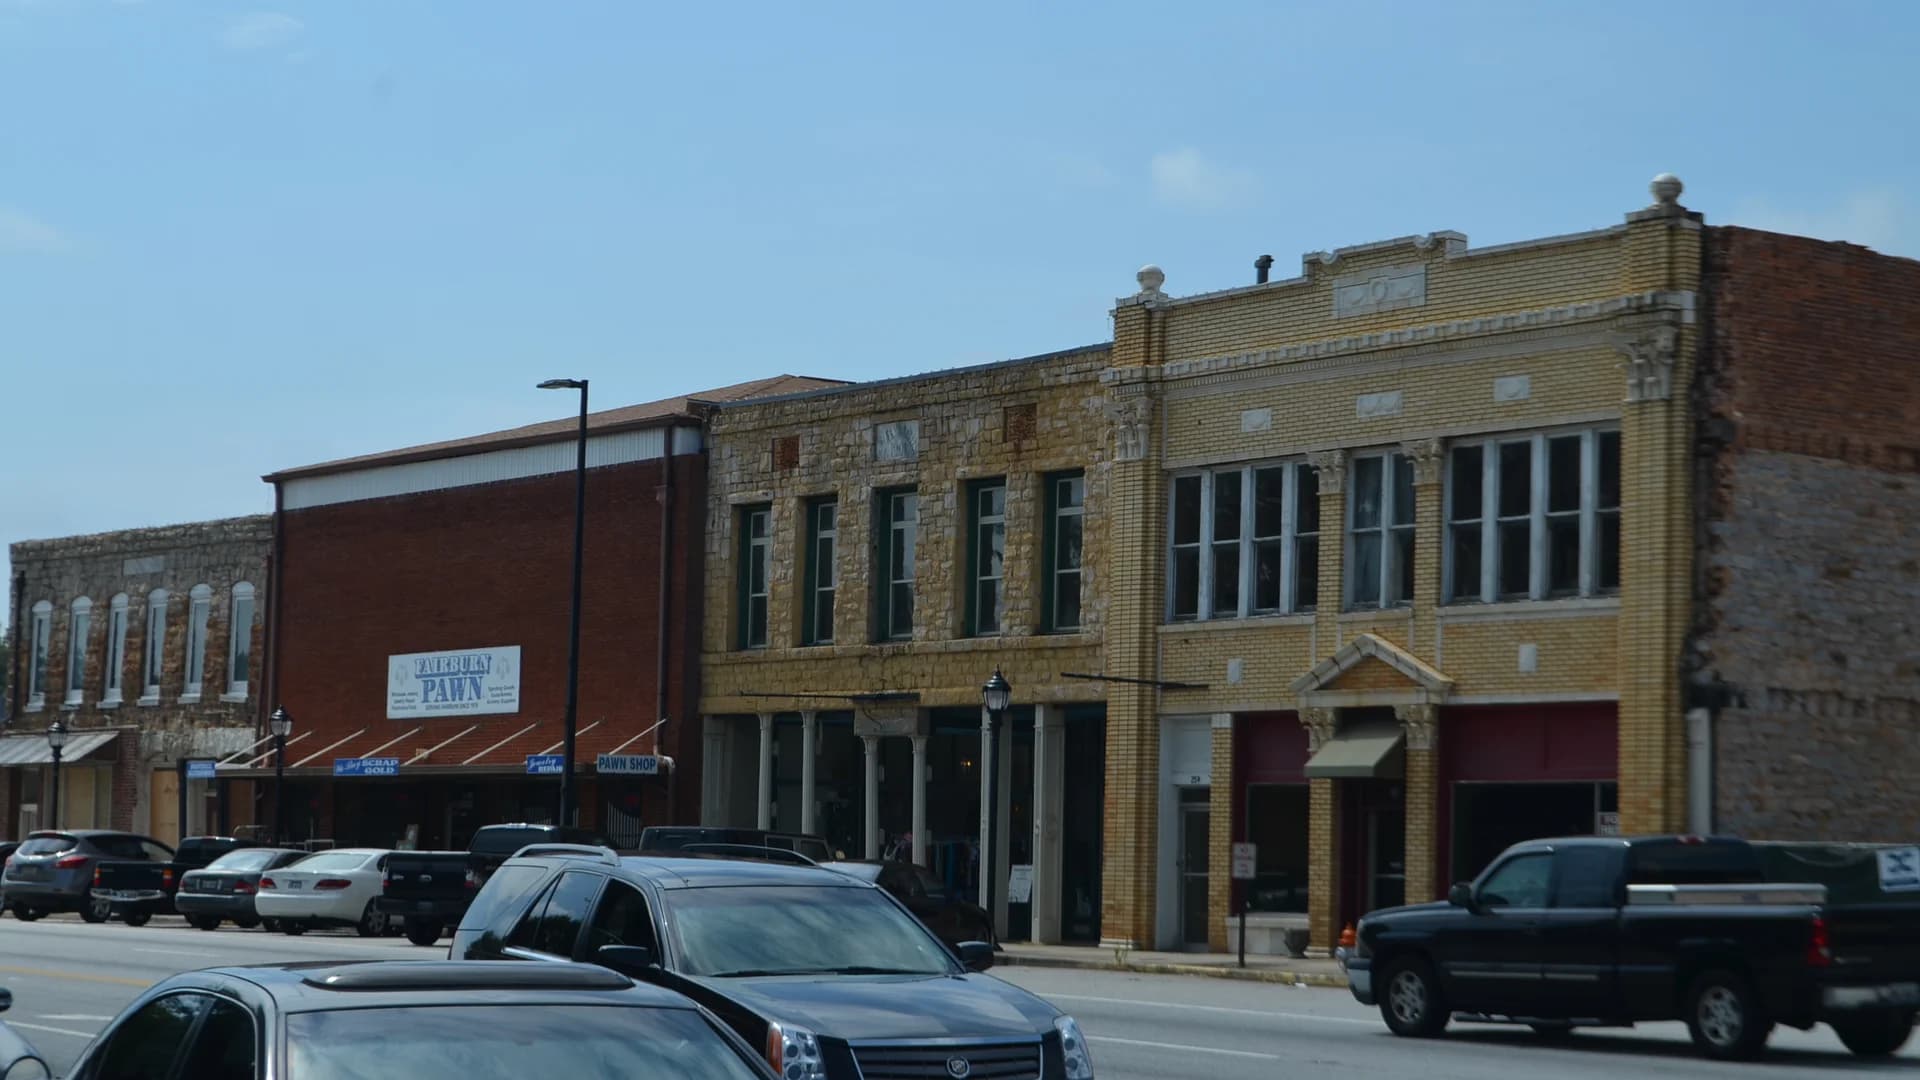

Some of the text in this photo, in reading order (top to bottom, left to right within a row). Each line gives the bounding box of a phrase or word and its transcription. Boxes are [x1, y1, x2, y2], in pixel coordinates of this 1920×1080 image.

[415, 653, 492, 676] FAIRBURN
[421, 675, 484, 703] PAWN
[361, 759, 399, 767] SCRAP
[364, 766, 395, 774] GOLD
[599, 756, 656, 771] PAWN SHOP
